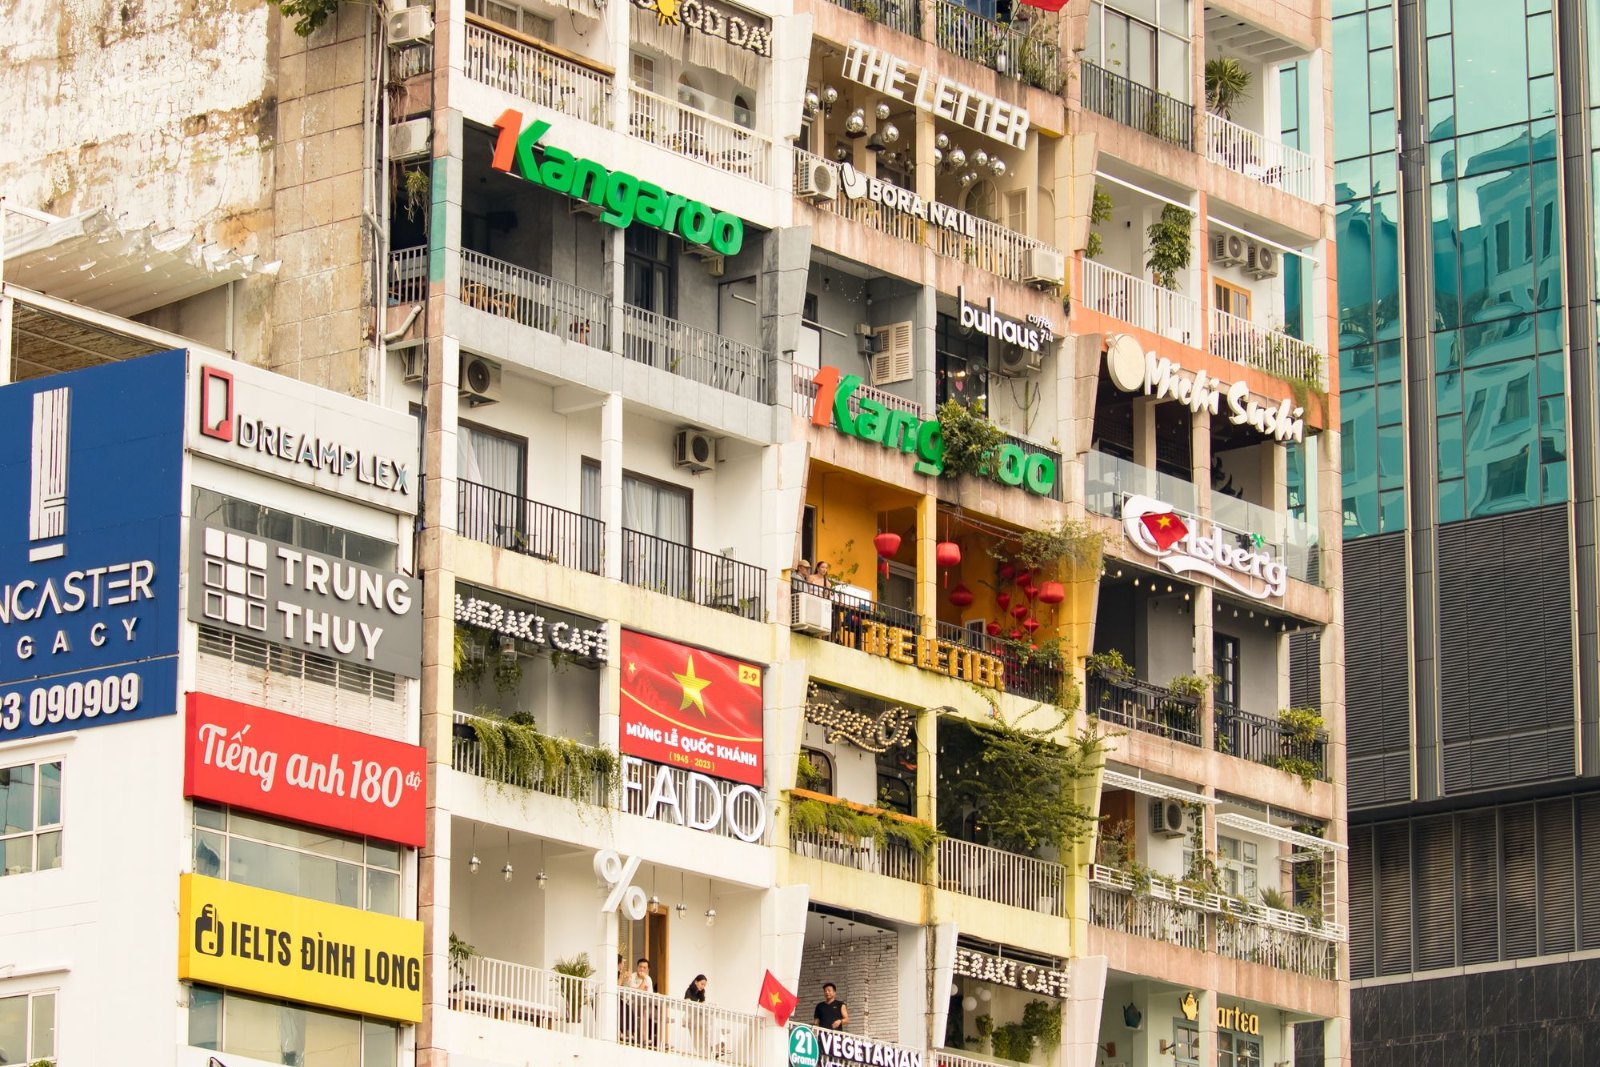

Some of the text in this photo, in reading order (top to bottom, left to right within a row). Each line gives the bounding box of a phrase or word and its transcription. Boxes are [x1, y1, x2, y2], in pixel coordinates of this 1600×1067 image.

[848, 38, 1030, 150] THE LETTER
[867, 180, 976, 237] BORA NAIL
[1143, 350, 1305, 444] Michi Sushi
[237, 414, 410, 496] DREAMPLEX
[1122, 494, 1288, 600] Clsberg
[276, 546, 412, 616] TRUNG
[16, 616, 138, 660] GACY
[276, 600, 384, 661] THUY
[0, 672, 140, 731] 3 090909
[199, 723, 278, 792] Tiếng
[350, 759, 404, 808] 180
[626, 721, 758, 767] MỪNG LỄ QUỐC KHÁNH
[621, 756, 767, 843] FADO
[231, 921, 421, 992] IELTS ĐÌNH LONG
[791, 1051, 816, 1067] Grams
[794, 1029, 812, 1055] 21
[820, 1031, 922, 1067] VEGETARIAN
